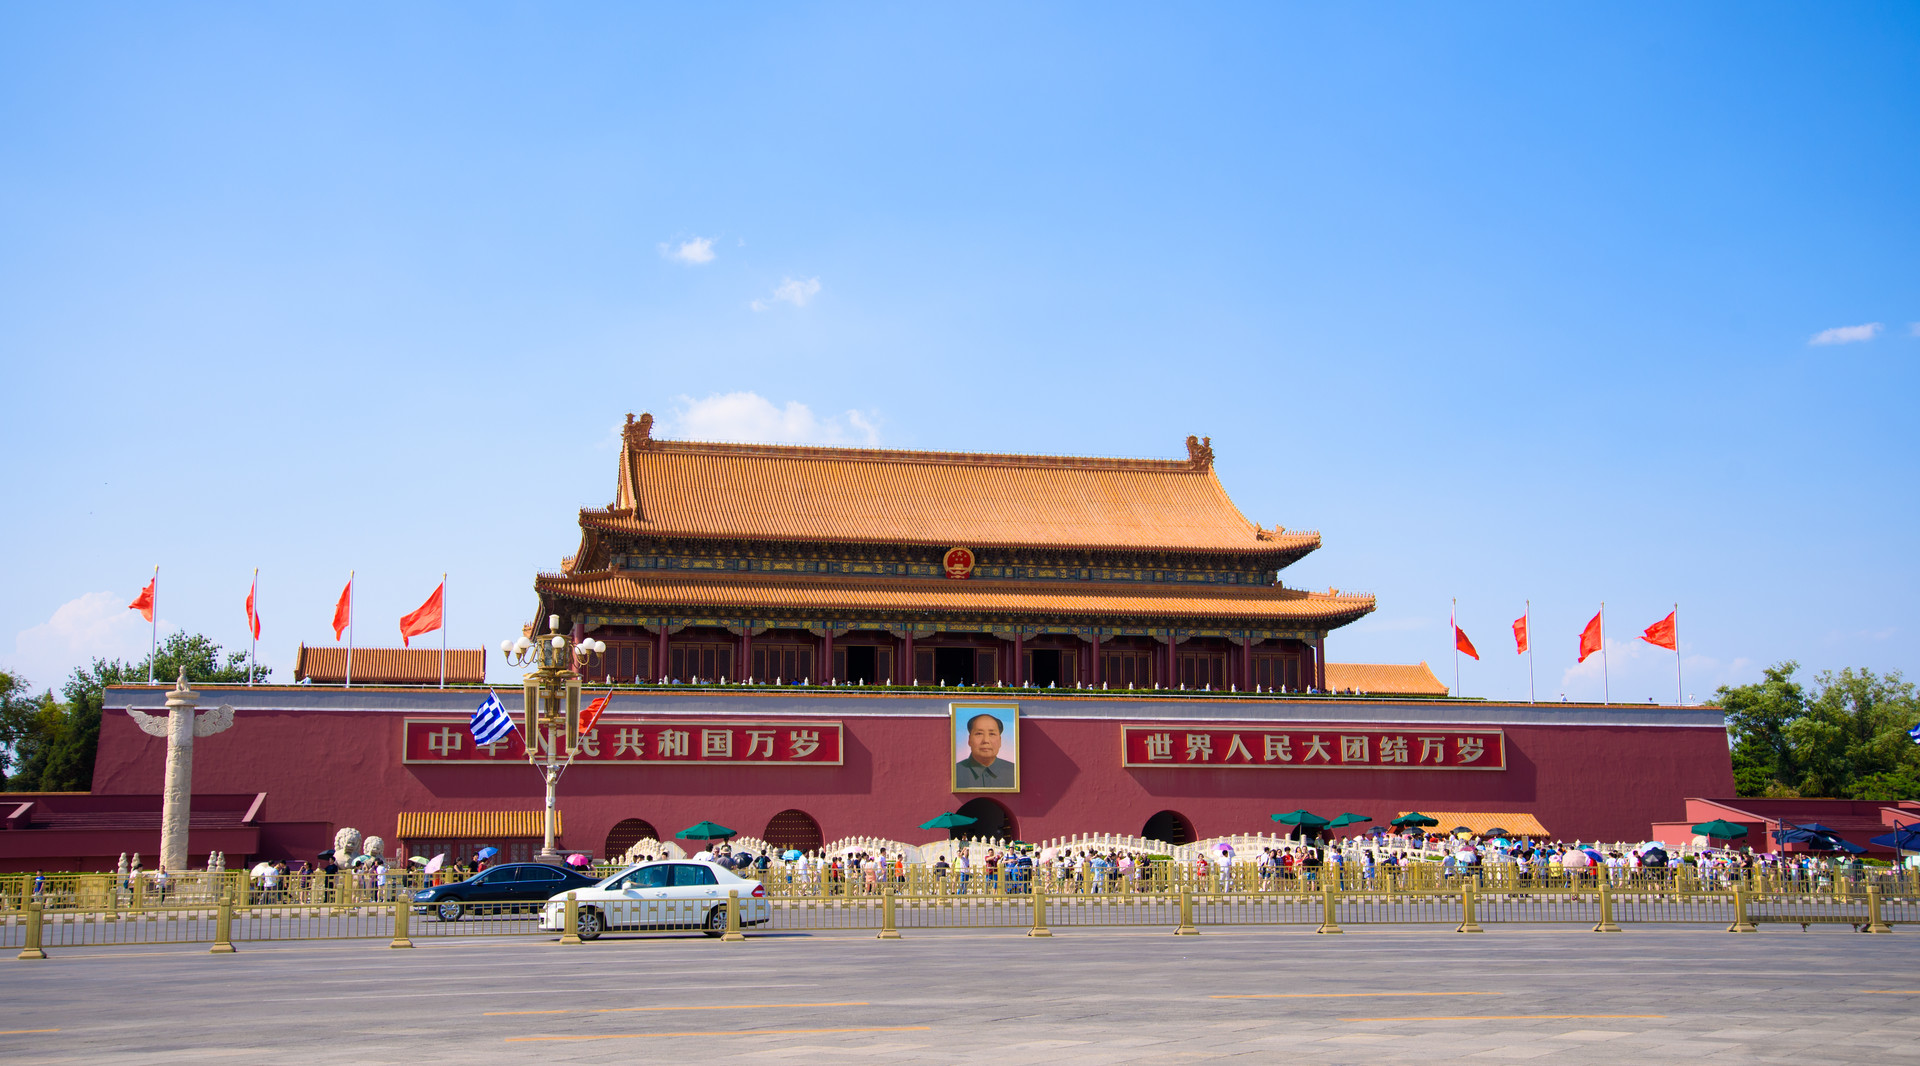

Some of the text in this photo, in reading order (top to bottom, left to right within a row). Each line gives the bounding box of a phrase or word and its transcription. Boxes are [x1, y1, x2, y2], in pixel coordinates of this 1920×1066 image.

[1144, 733, 1485, 764] 世界人民大团结万岁
